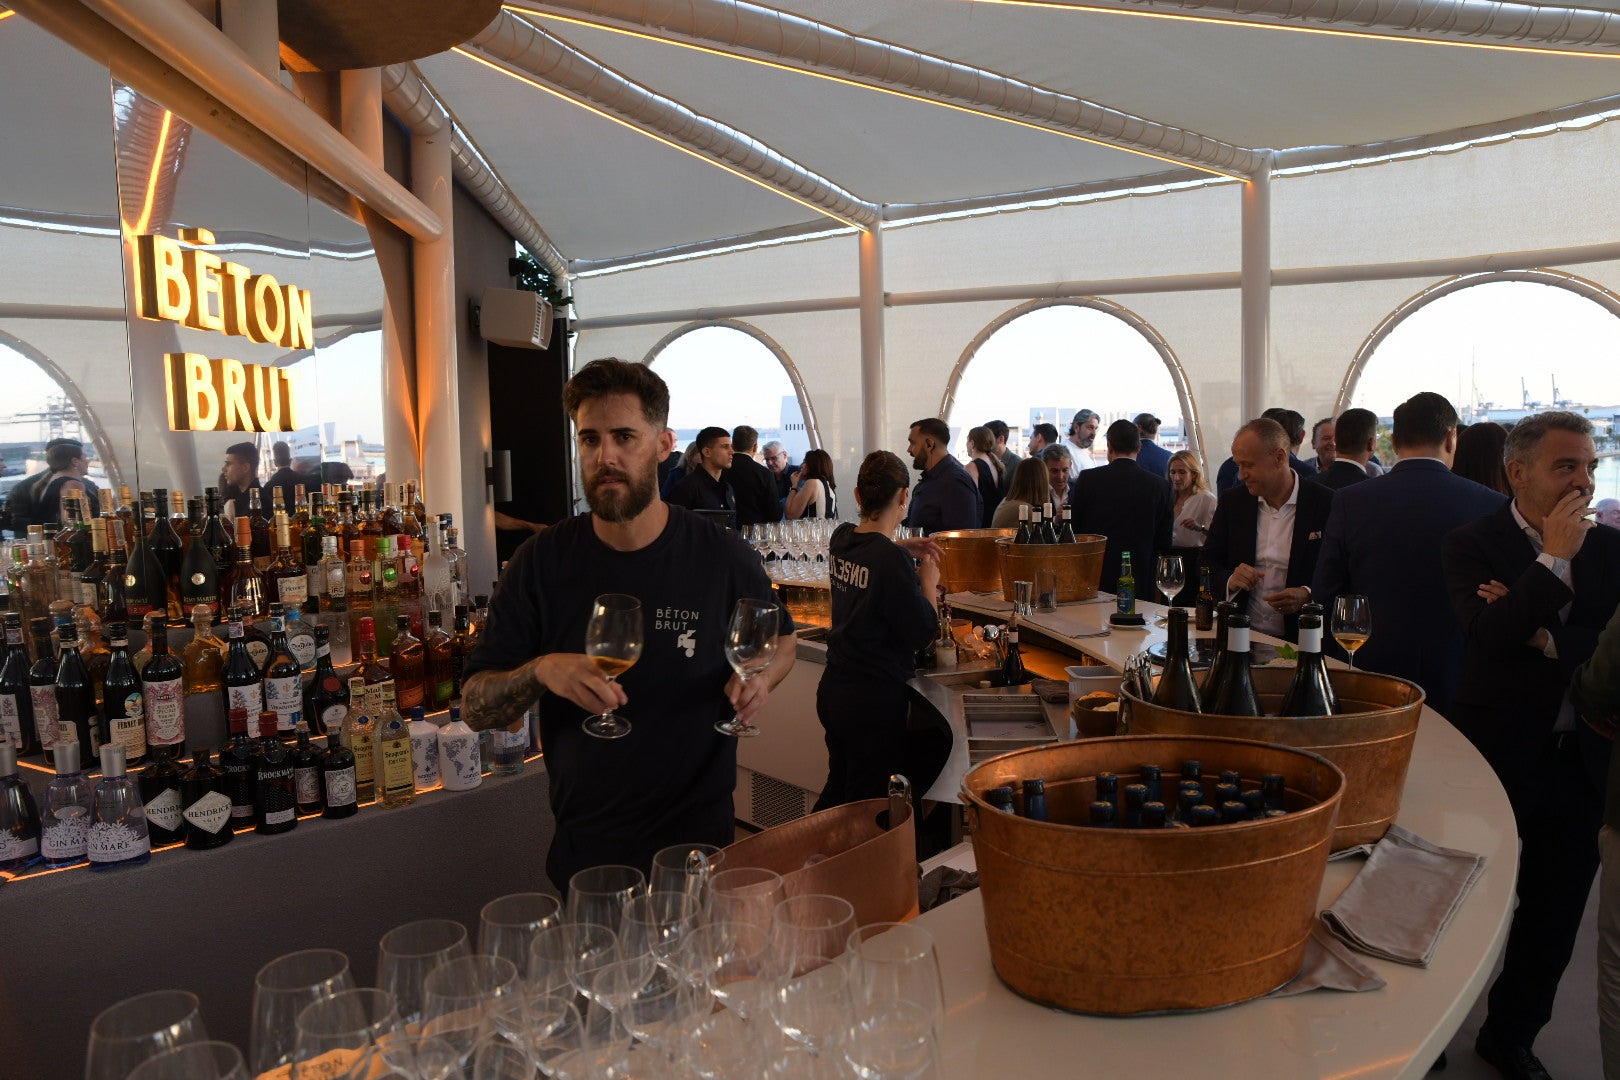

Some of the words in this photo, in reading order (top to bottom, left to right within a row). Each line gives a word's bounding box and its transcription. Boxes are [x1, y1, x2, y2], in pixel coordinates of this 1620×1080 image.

[164, 353, 303, 432] BRUT
[655, 620, 689, 631] BRUT
[50, 839, 68, 849] GIN
[70, 837, 88, 846] MA
[101, 841, 131, 851] MARE
